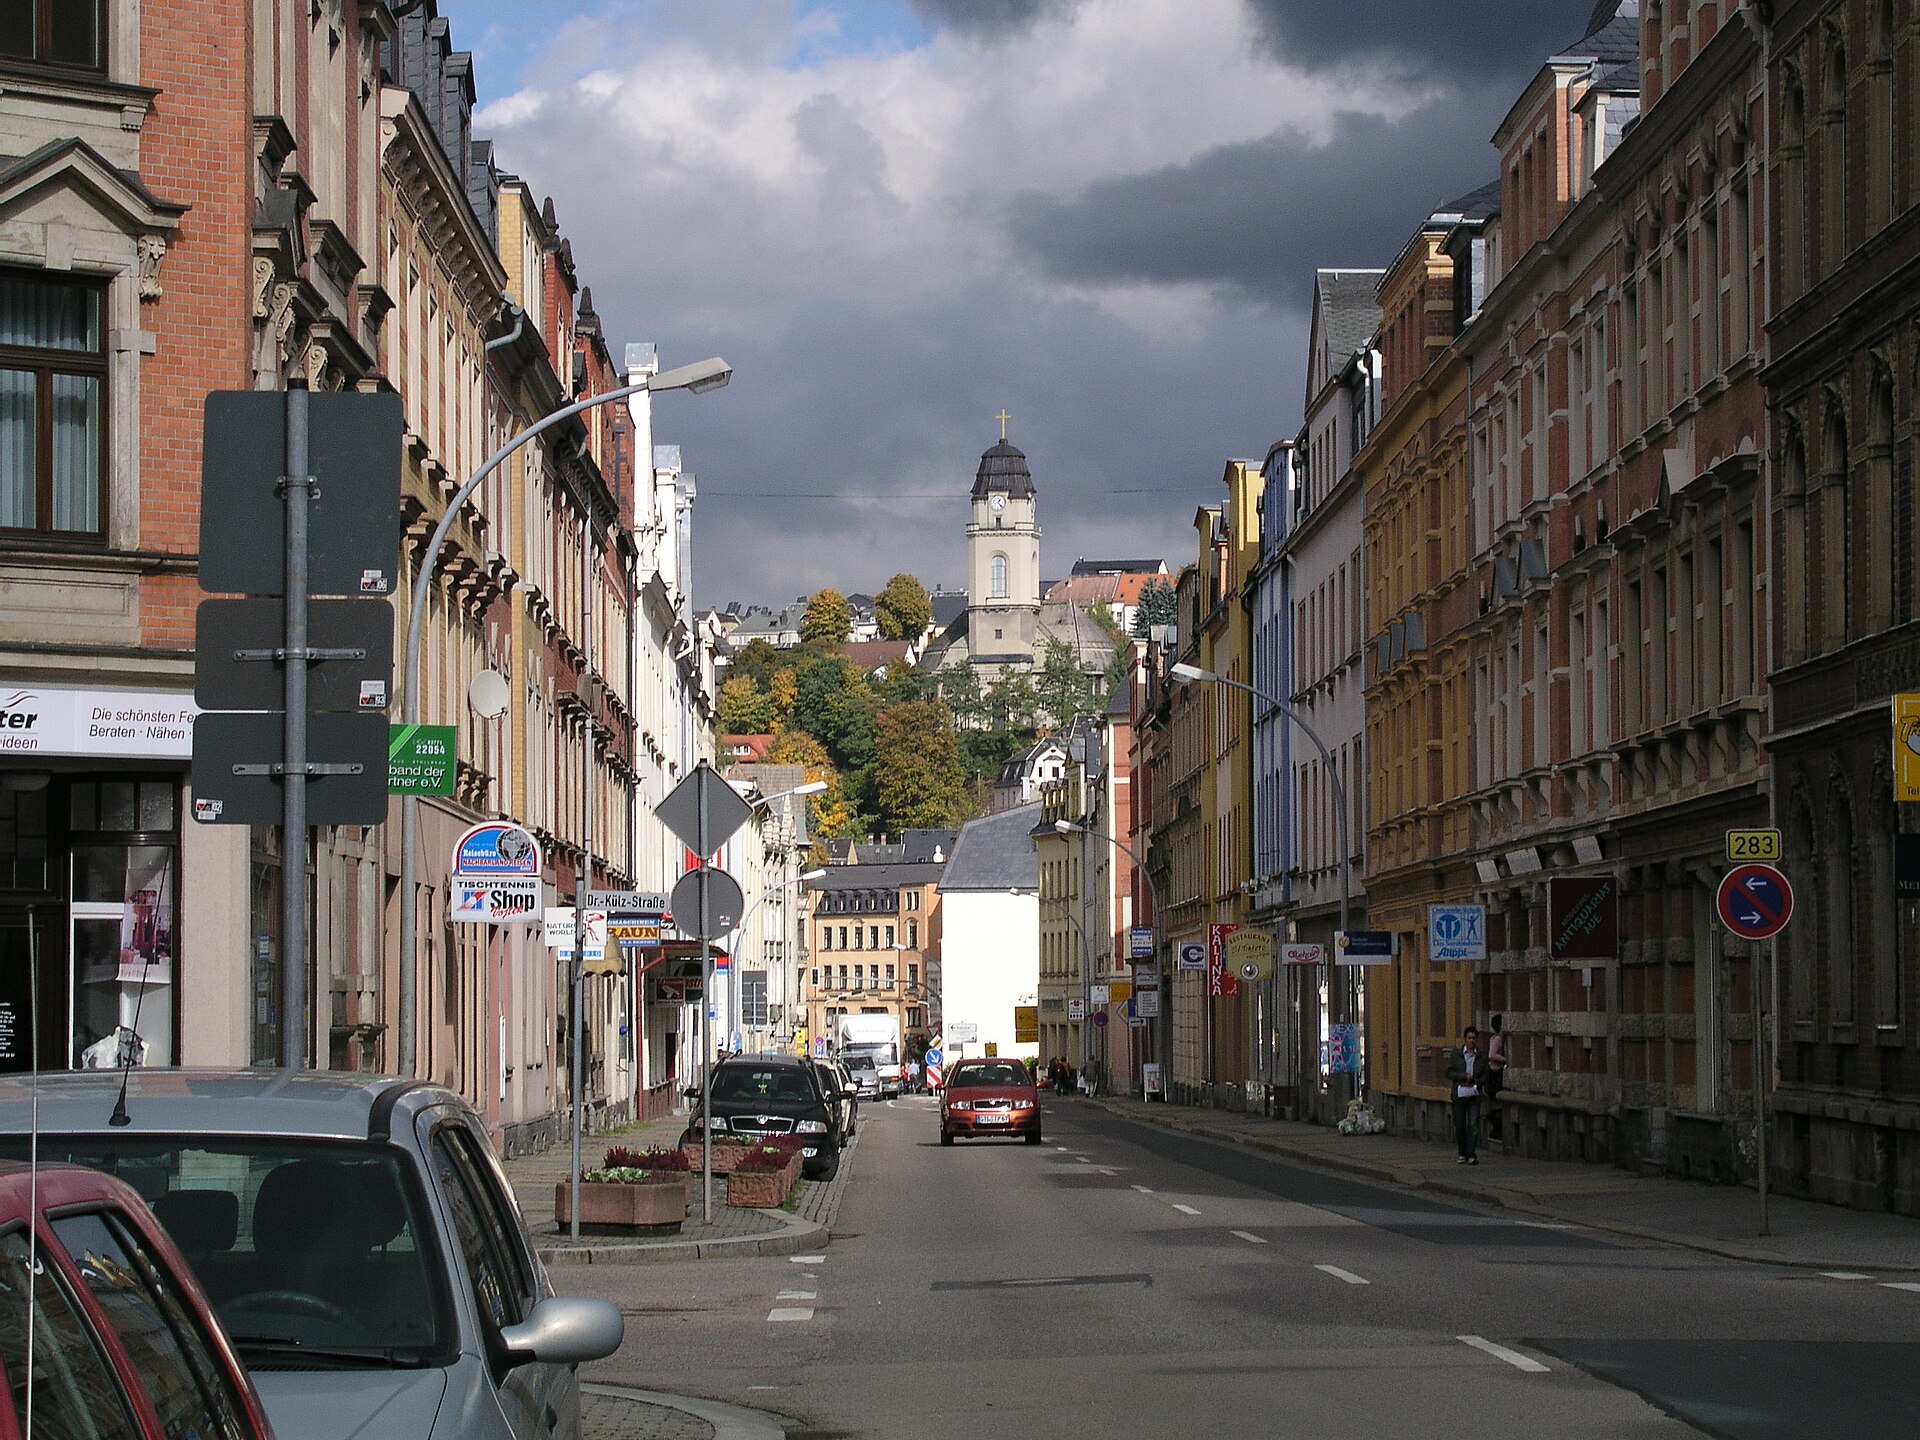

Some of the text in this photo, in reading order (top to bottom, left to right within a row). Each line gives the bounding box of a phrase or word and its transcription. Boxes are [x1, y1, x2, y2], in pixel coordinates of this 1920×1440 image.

[0, 710, 38, 729] ter
[92, 708, 196, 723] Die schönsten Fe
[89, 725, 185, 739] Beraten Nähen
[0, 736, 38, 749] ideen
[416, 745, 445, 755] 22054
[388, 765, 446, 777] band der
[388, 777, 417, 787] rtner
[1735, 836, 1773, 855] 283
[457, 881, 537, 889] TISCHTENNIS
[490, 890, 535, 912] Shop
[587, 894, 665, 909] Dr.-Külz-Straße
[1555, 882, 1611, 951] ANTIQUARIAT
[607, 927, 658, 938] RAUN
[1212, 925, 1222, 996] KALINKA
